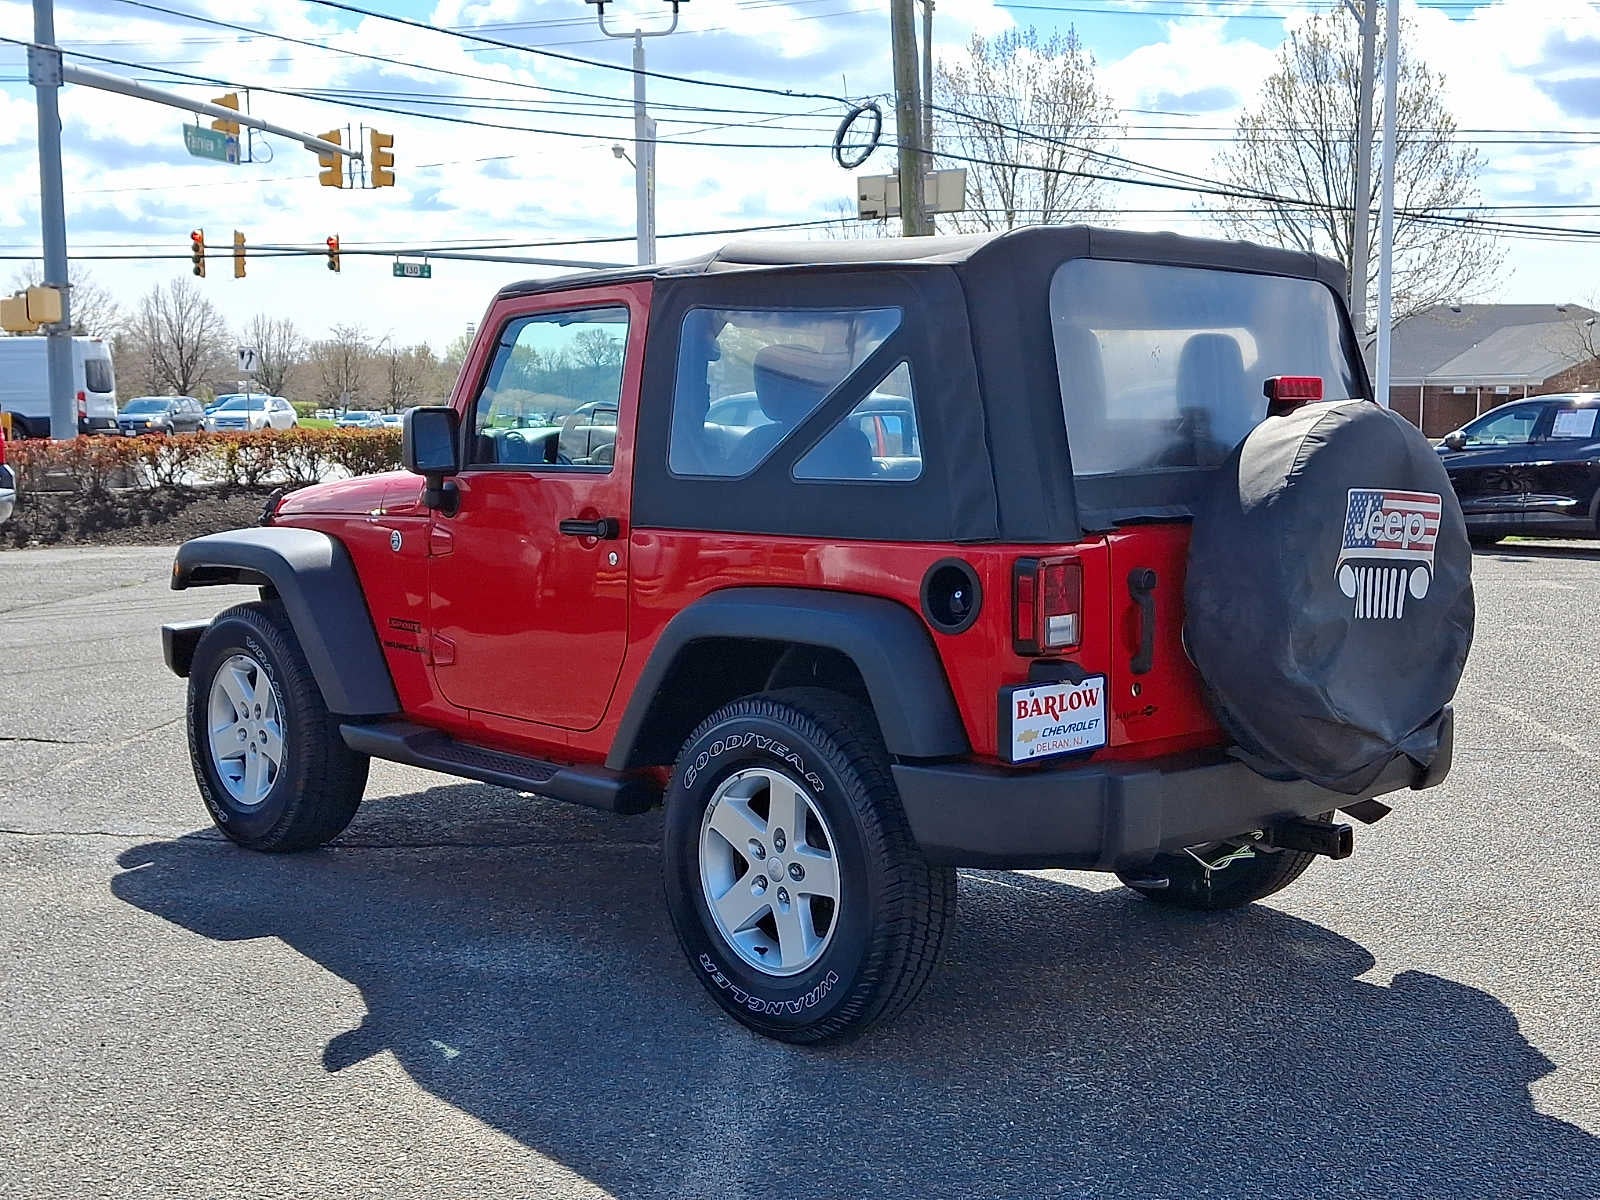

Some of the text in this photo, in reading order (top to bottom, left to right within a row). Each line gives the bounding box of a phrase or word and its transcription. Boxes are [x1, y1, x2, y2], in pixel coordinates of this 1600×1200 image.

[1354, 499, 1425, 549] Jeep
[1016, 687, 1100, 722] BARLOW
[1041, 718, 1101, 738] CHEVROLET
[1073, 736, 1083, 746] NJ
[684, 733, 825, 793] GOODYEAR
[700, 953, 839, 1016] WRANGLER
